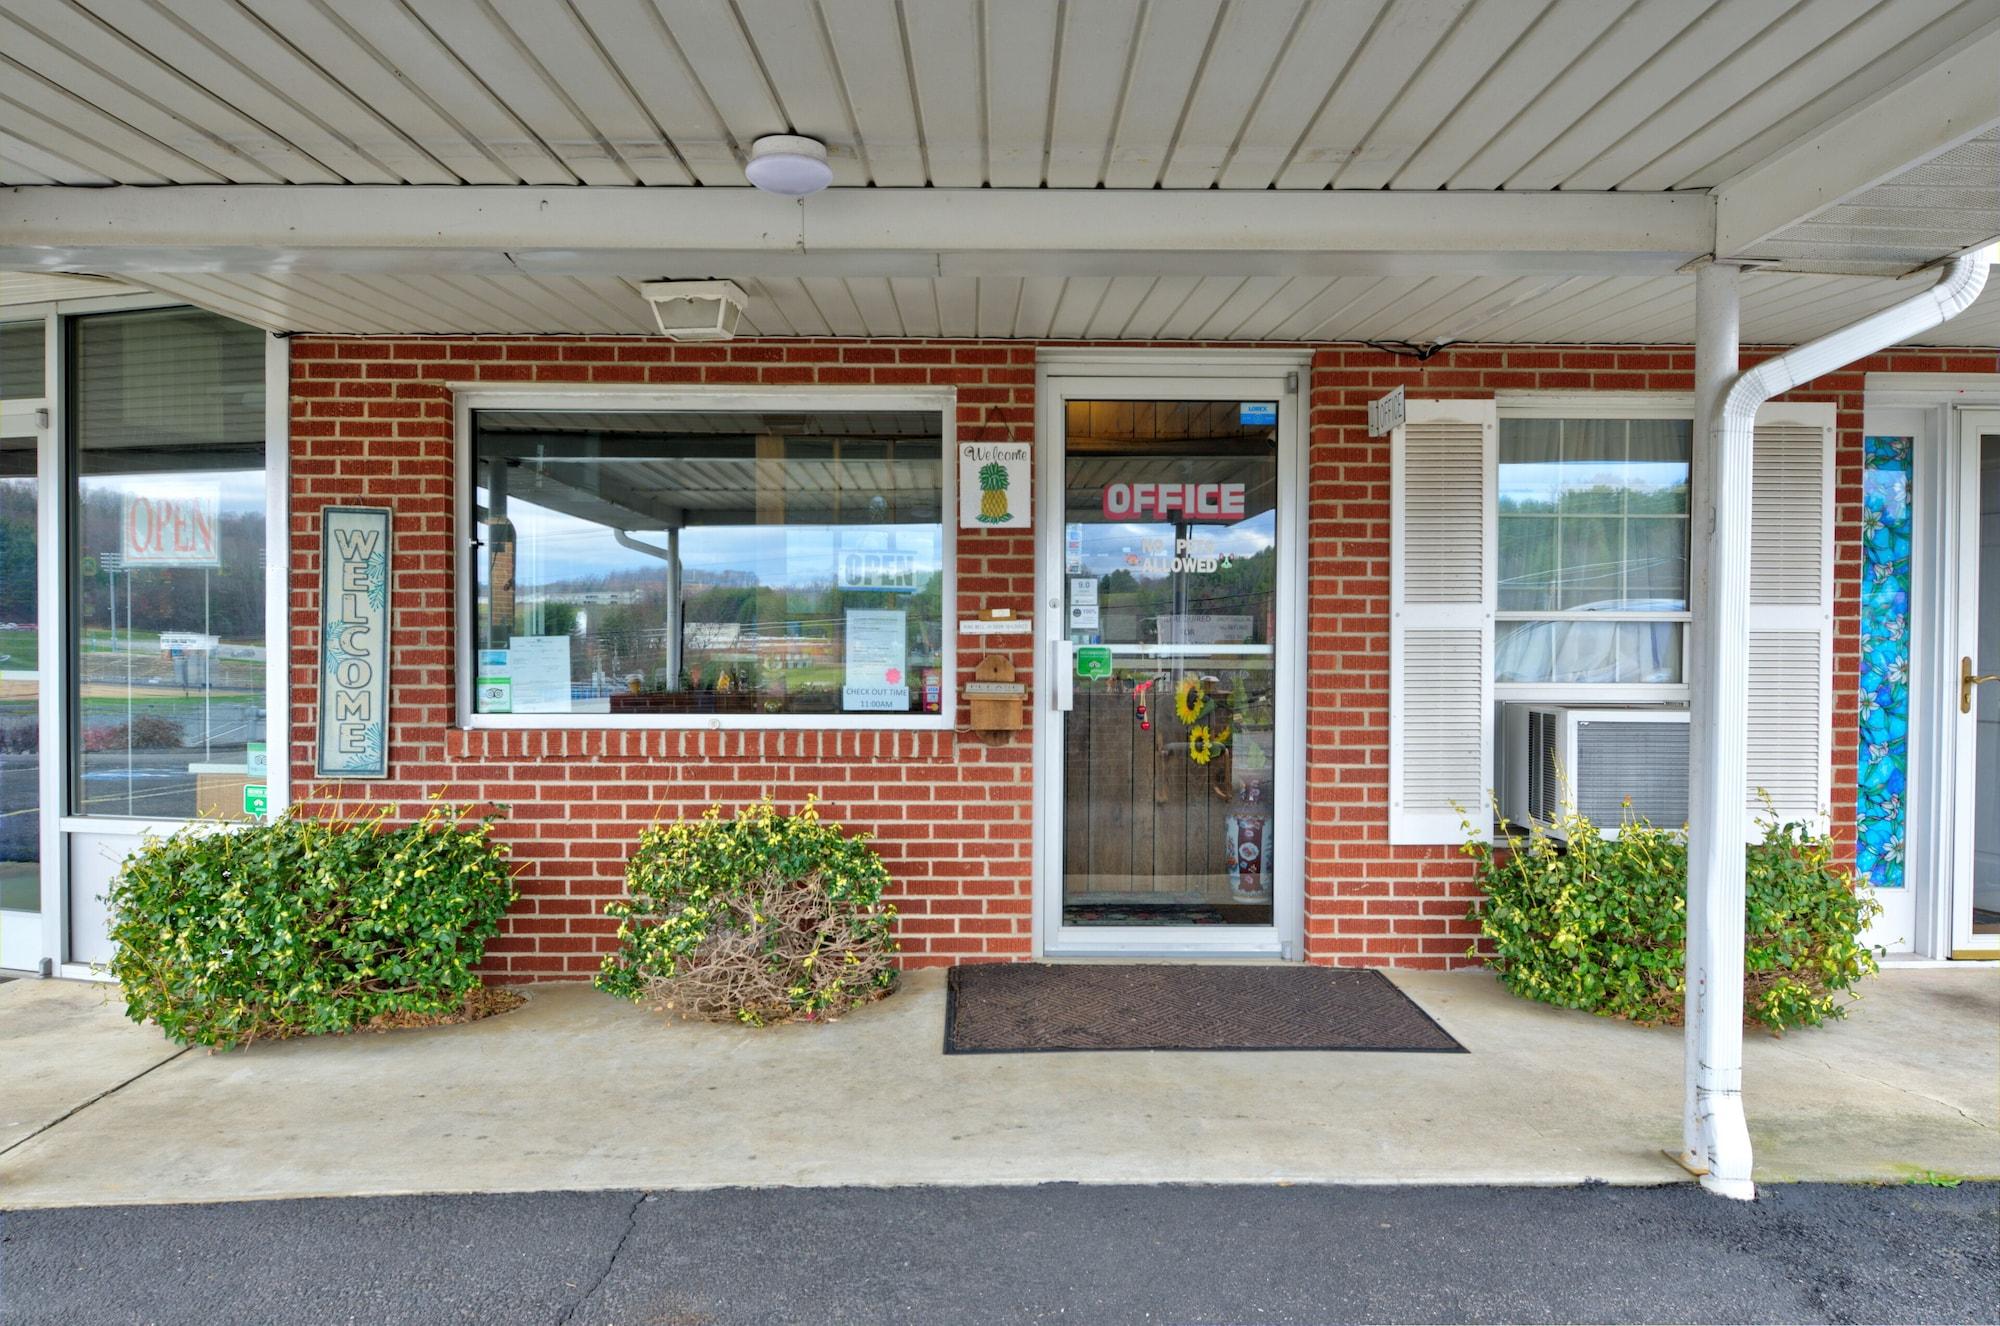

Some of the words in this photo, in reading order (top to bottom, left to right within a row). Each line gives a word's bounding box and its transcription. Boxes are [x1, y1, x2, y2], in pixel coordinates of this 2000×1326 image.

[963, 445, 1028, 461] Welcome
[1104, 483, 1246, 520] OFFICE
[129, 497, 213, 553] OPEN
[1142, 538, 1164, 553] NO
[845, 554, 914, 586] OPEN
[1142, 557, 1217, 573] ALLOWED
[334, 529, 379, 754] WELCOME
[846, 688, 869, 696] CHECK
[872, 688, 887, 696] OUT
[889, 688, 907, 697] TIME
